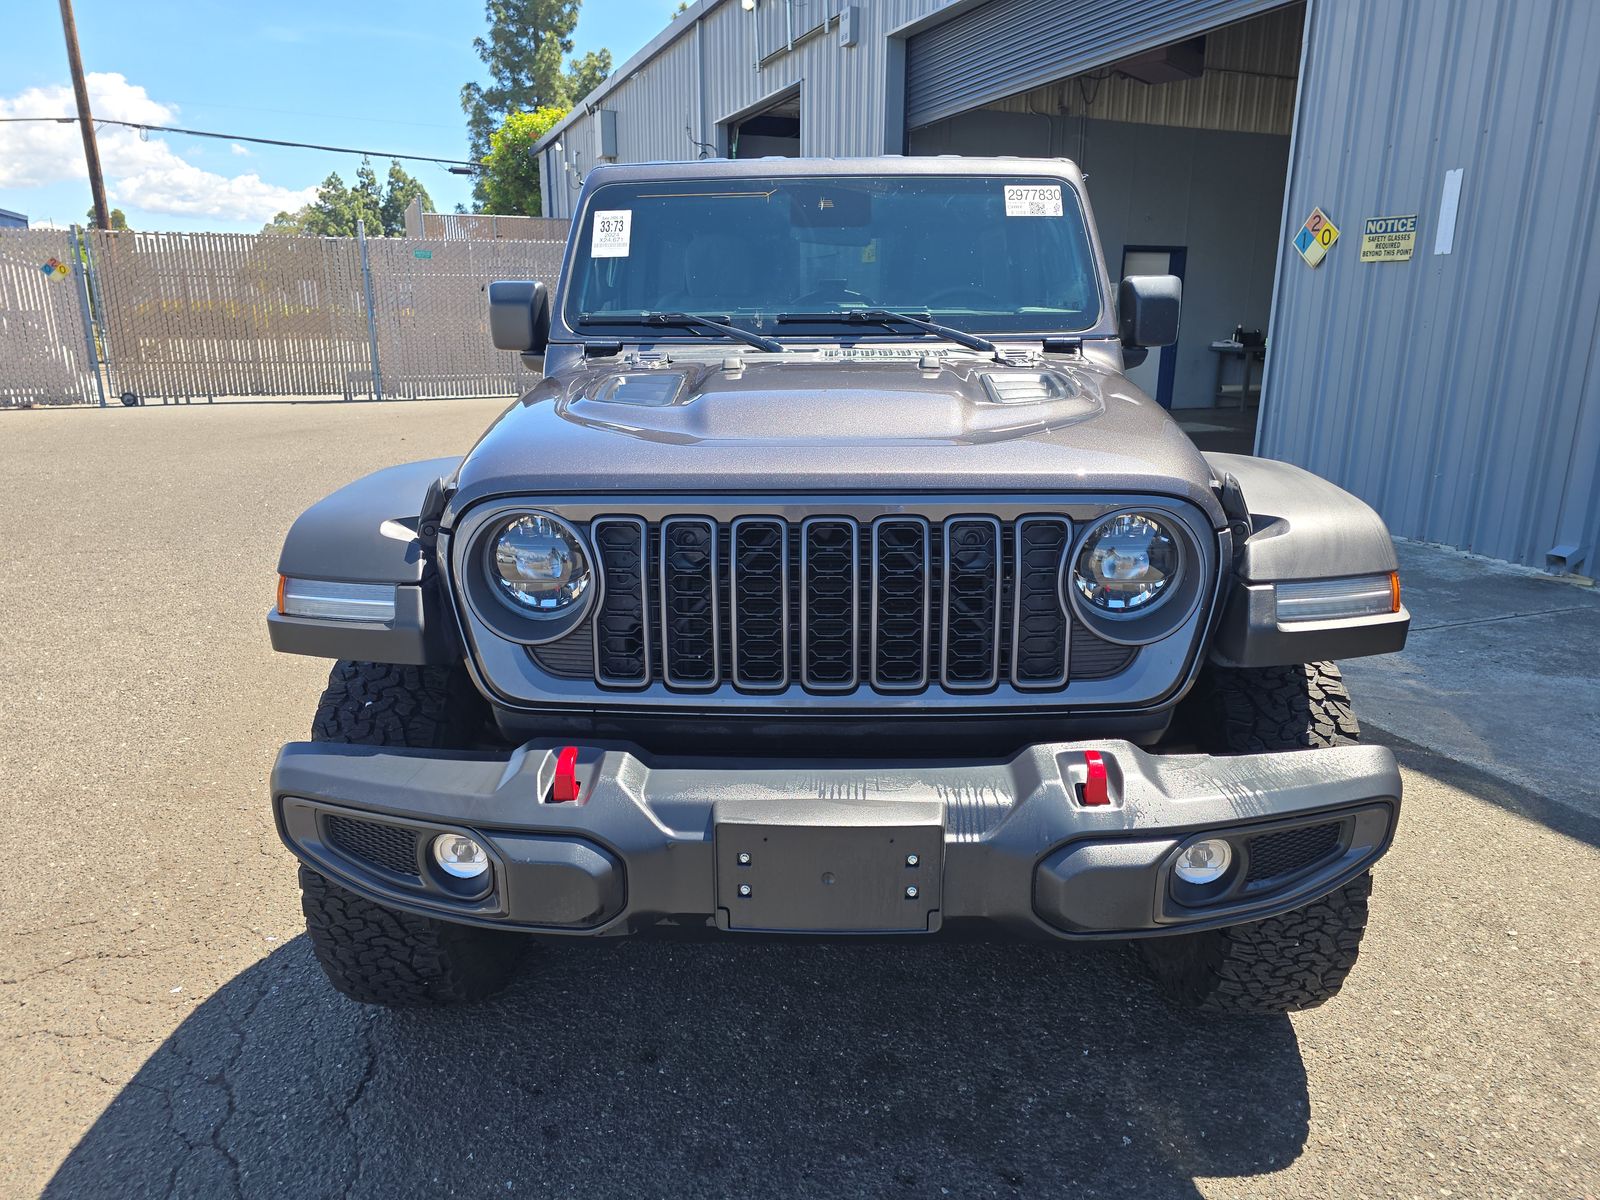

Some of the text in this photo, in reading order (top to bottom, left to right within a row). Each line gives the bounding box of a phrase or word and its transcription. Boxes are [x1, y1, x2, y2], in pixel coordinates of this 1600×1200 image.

[1008, 189, 1061, 201] 2977830
[600, 220, 624, 233] 33:73
[1311, 214, 1322, 232] 2
[1366, 218, 1416, 234] NOTICE
[1302, 231, 1307, 249] 1
[1321, 228, 1332, 246] 0
[50, 258, 58, 267] 2
